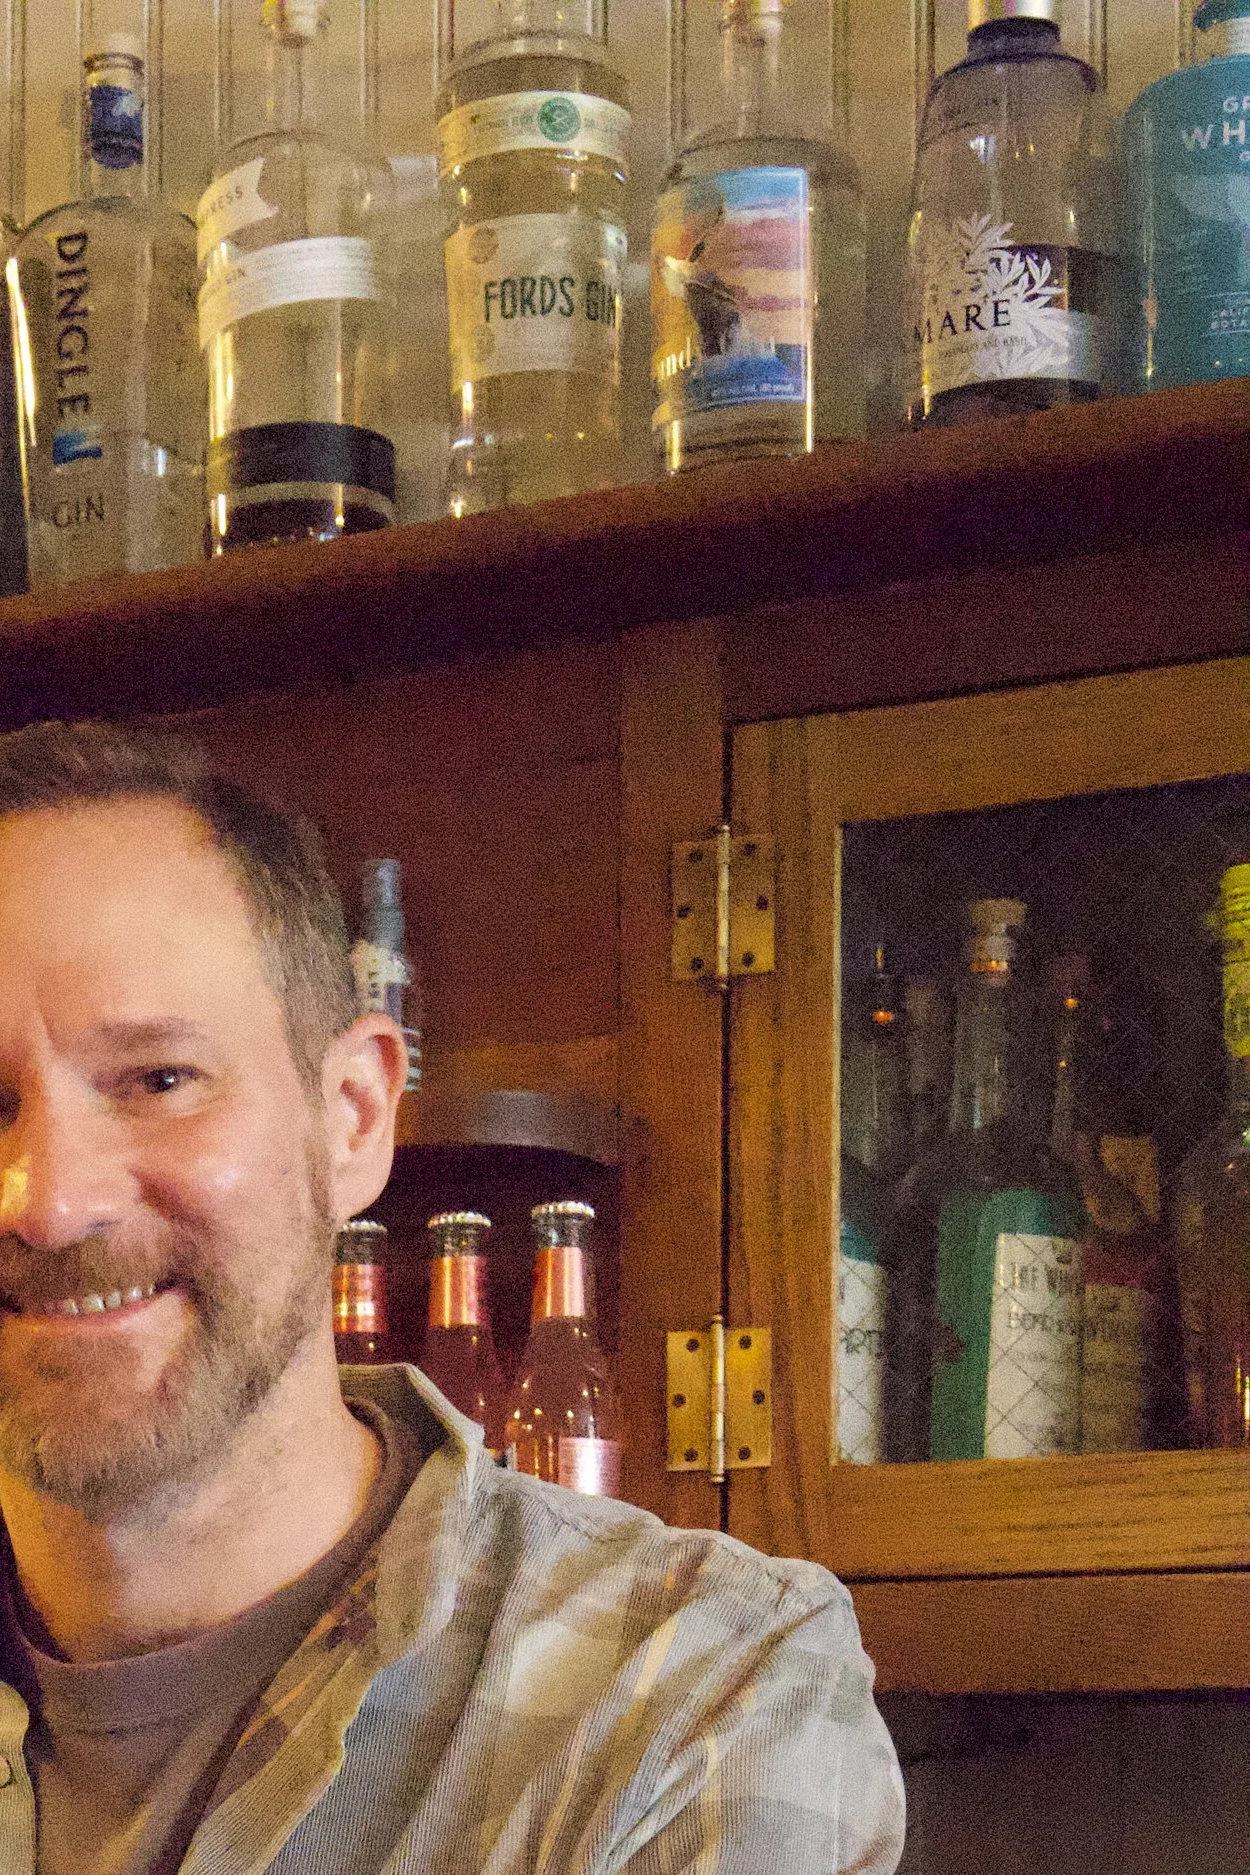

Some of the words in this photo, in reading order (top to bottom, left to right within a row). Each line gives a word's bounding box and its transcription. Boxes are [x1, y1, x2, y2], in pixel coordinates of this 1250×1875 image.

[483, 276, 576, 322] FORDS
[913, 299, 1012, 344] MARE
[56, 232, 89, 417] DINGLE
[52, 492, 106, 530] GIN
